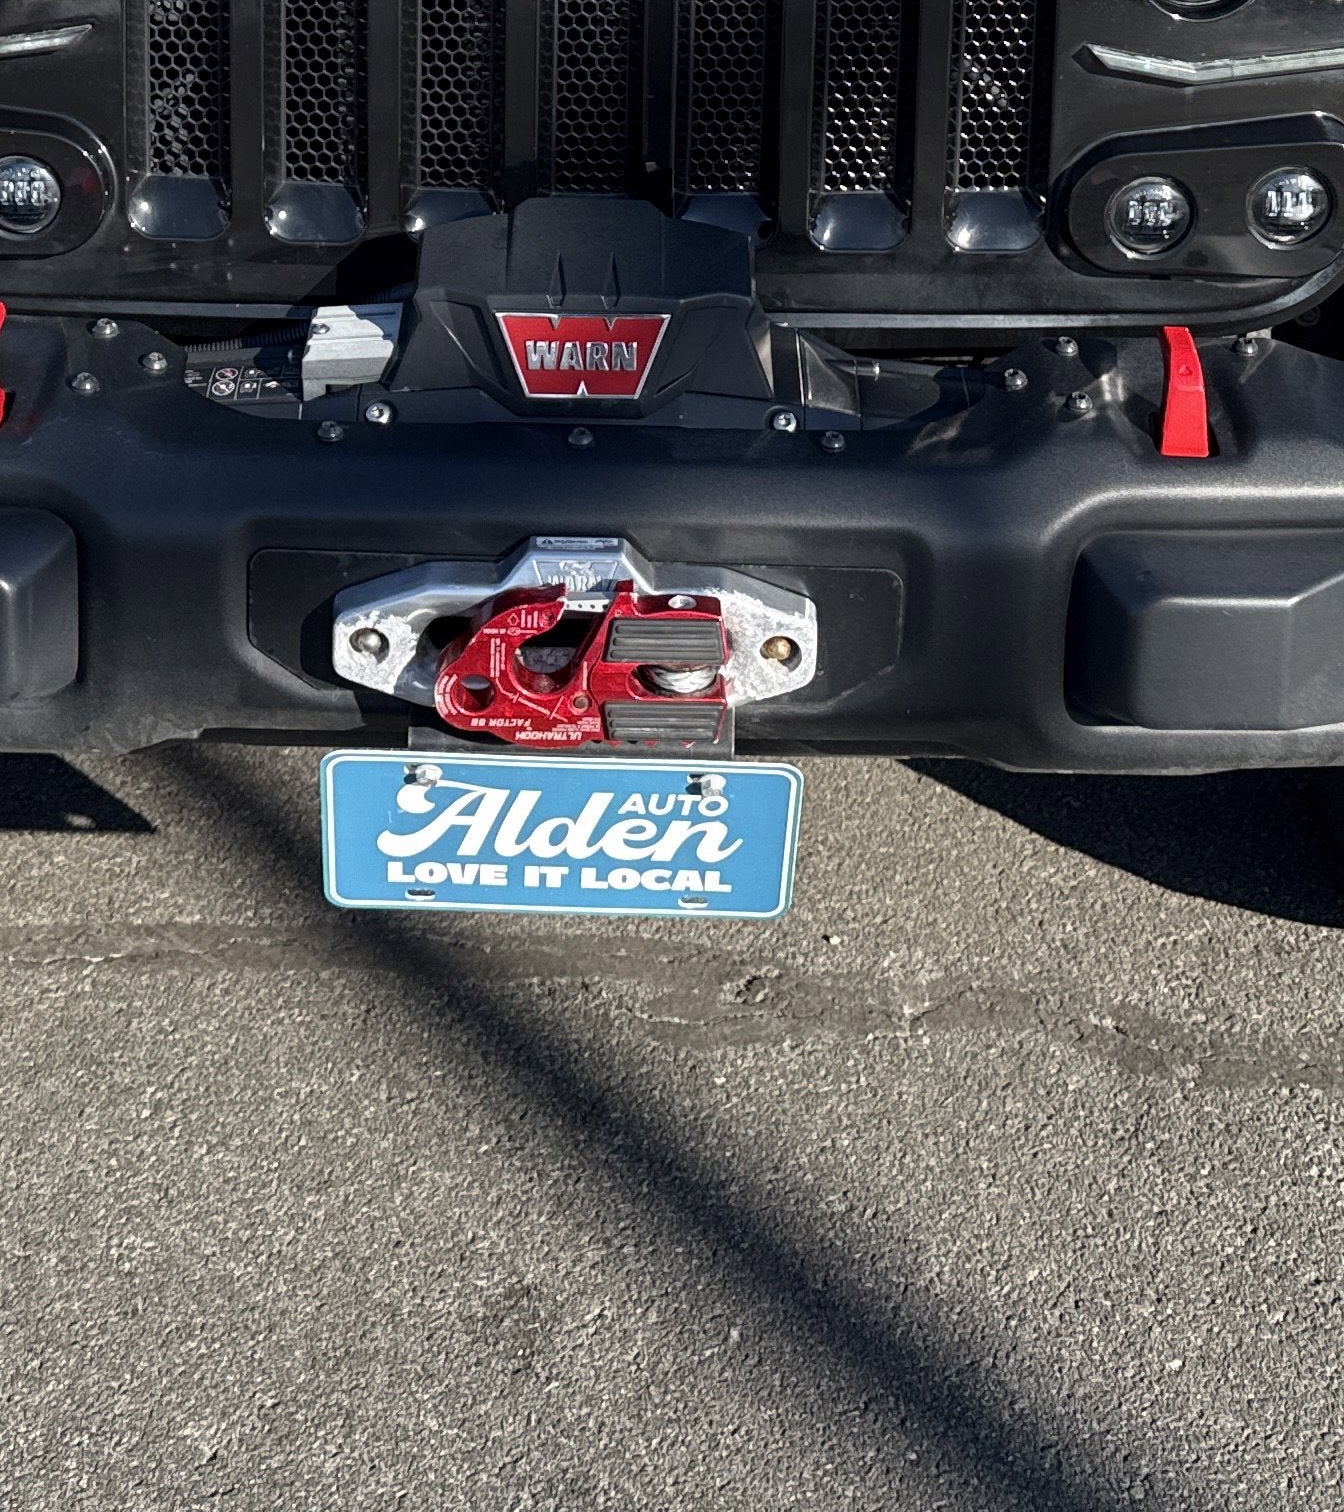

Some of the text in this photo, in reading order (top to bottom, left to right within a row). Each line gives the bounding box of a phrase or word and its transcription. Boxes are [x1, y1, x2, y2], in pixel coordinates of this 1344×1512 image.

[525, 340, 638, 371] WARN
[618, 792, 728, 816] AUTO
[377, 779, 743, 864] Alden
[387, 861, 732, 893] LOVE IT LOCAL
